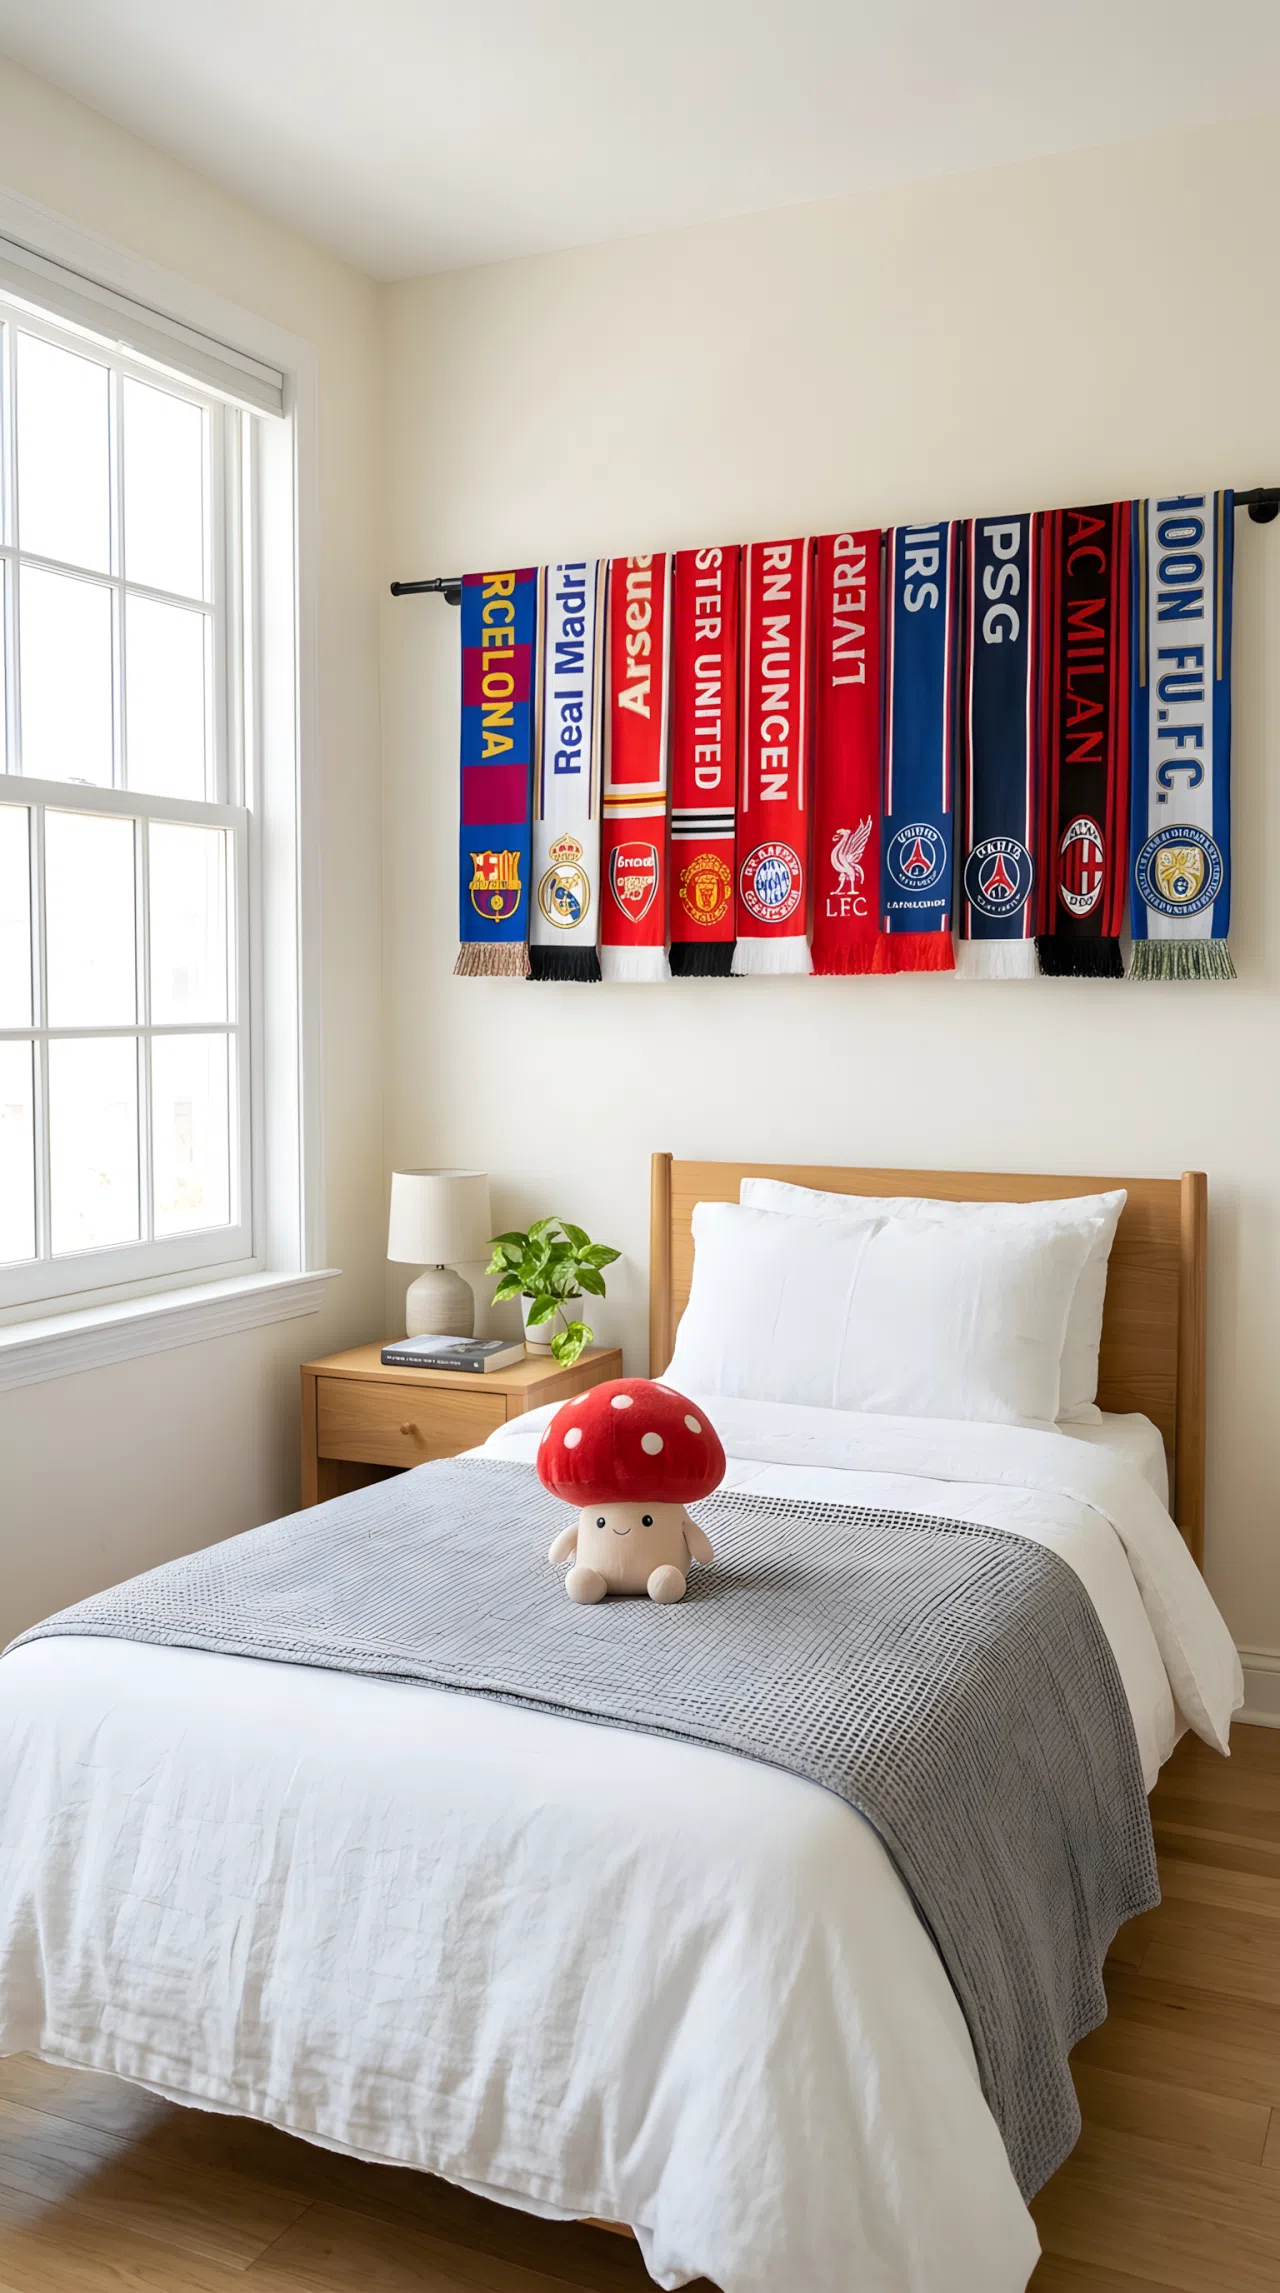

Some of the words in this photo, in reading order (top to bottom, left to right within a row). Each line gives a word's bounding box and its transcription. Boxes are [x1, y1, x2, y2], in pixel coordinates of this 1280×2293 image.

[694, 547, 723, 641] STER
[762, 544, 792, 603] RN
[902, 522, 940, 613] IRS
[982, 521, 1021, 645] PSG
[1065, 511, 1107, 577] AC
[482, 572, 515, 758] RCELONA
[554, 562, 587, 676] Madri
[831, 533, 867, 688] LIVERP
[554, 690, 582, 775] Real
[693, 654, 722, 790] UNITED
[759, 615, 790, 802] MUNCEN
[1065, 598, 1106, 764] MILAN
[826, 896, 869, 918] LFC
